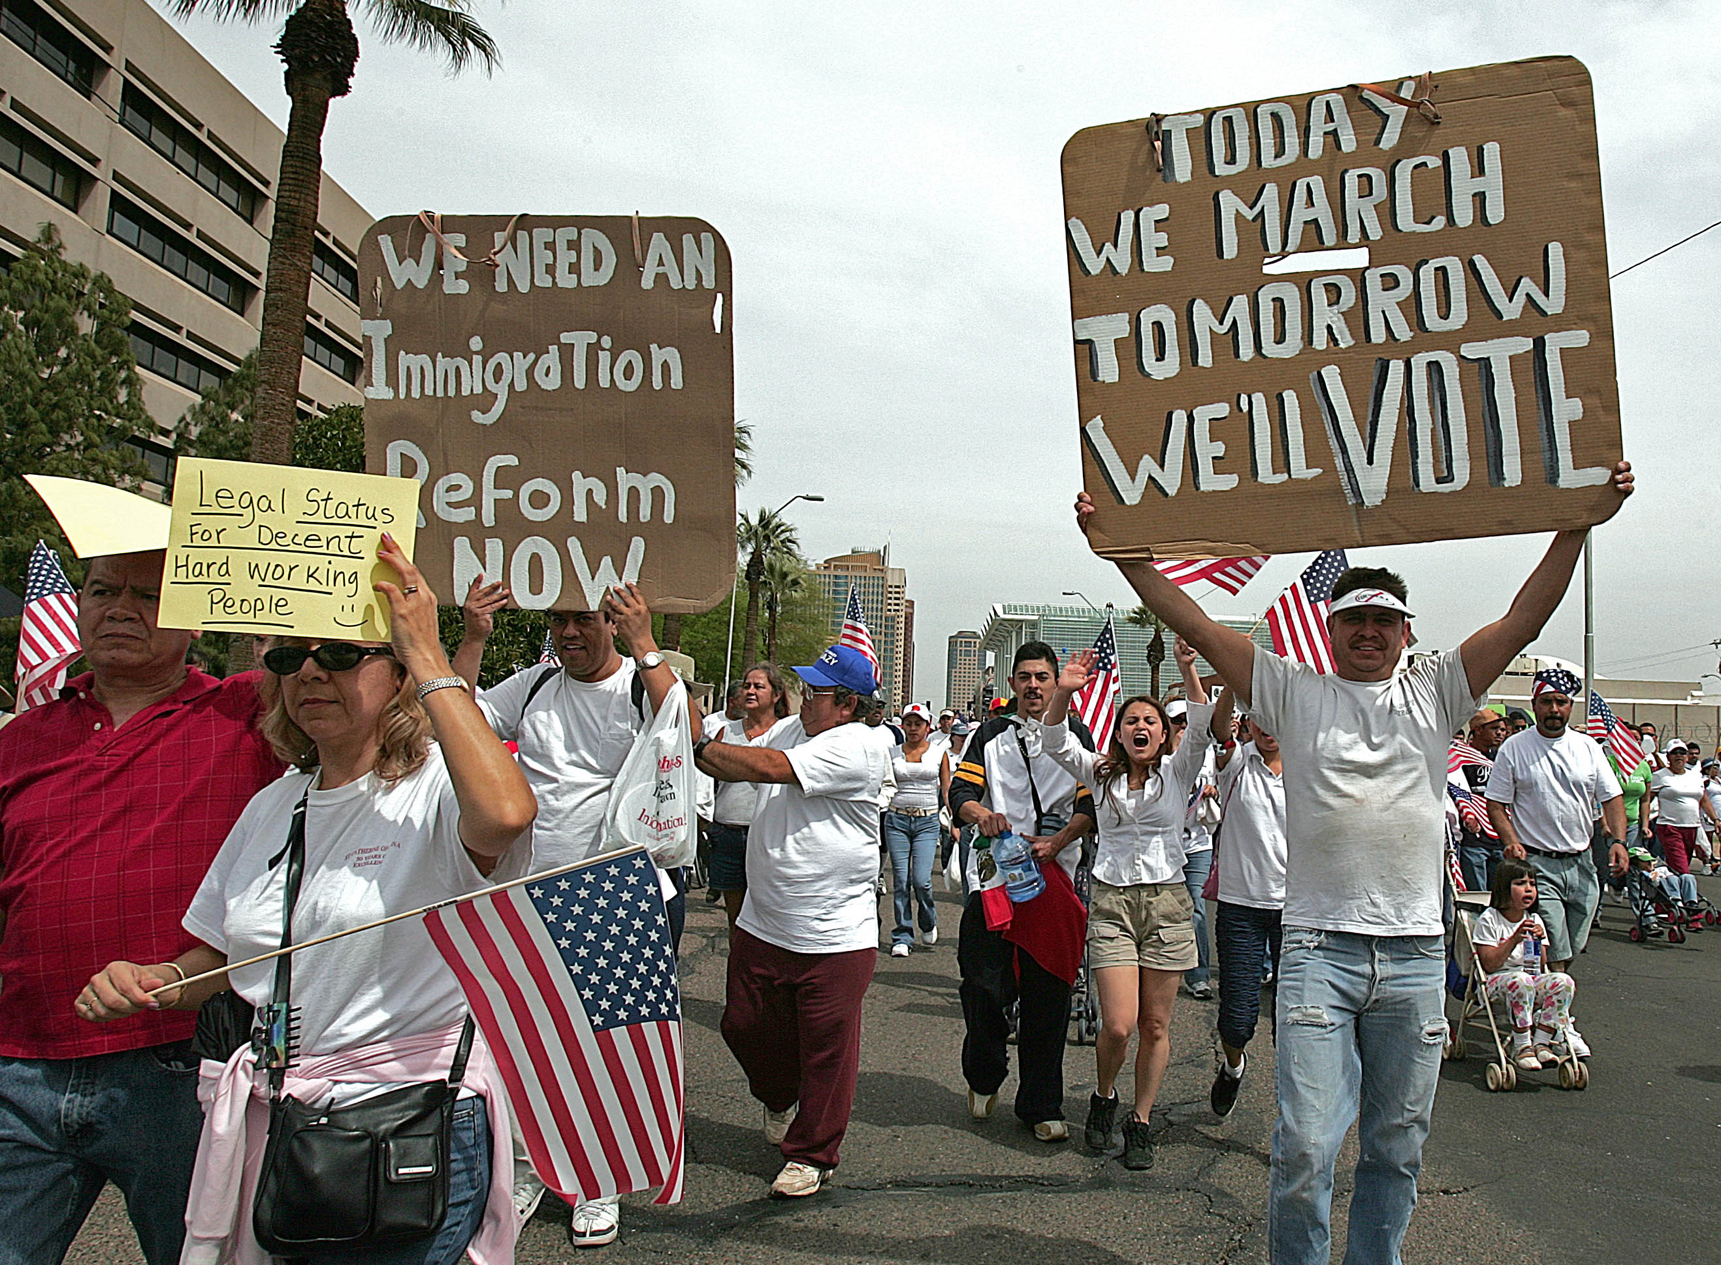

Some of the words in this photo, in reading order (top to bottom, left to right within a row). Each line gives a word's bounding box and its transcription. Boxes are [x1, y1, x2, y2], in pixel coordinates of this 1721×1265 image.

[1159, 80, 1416, 183] TODAY
[1067, 203, 1175, 276] WE
[1213, 141, 1505, 259] MARCH
[377, 232, 470, 294] WE
[493, 227, 617, 293] NEED
[641, 232, 716, 290] AN
[1074, 241, 1567, 383] TOMORROW
[1083, 389, 1323, 506] WE'LL
[1310, 329, 1612, 508] VOTE
[199, 470, 286, 528] Legal
[302, 487, 395, 524] Status
[386, 440, 676, 528] Reform
[174, 555, 231, 578] Hard
[189, 523, 227, 545] For
[257, 525, 365, 555] Decent
[453, 536, 645, 611] NOW
[208, 588, 294, 619] People
